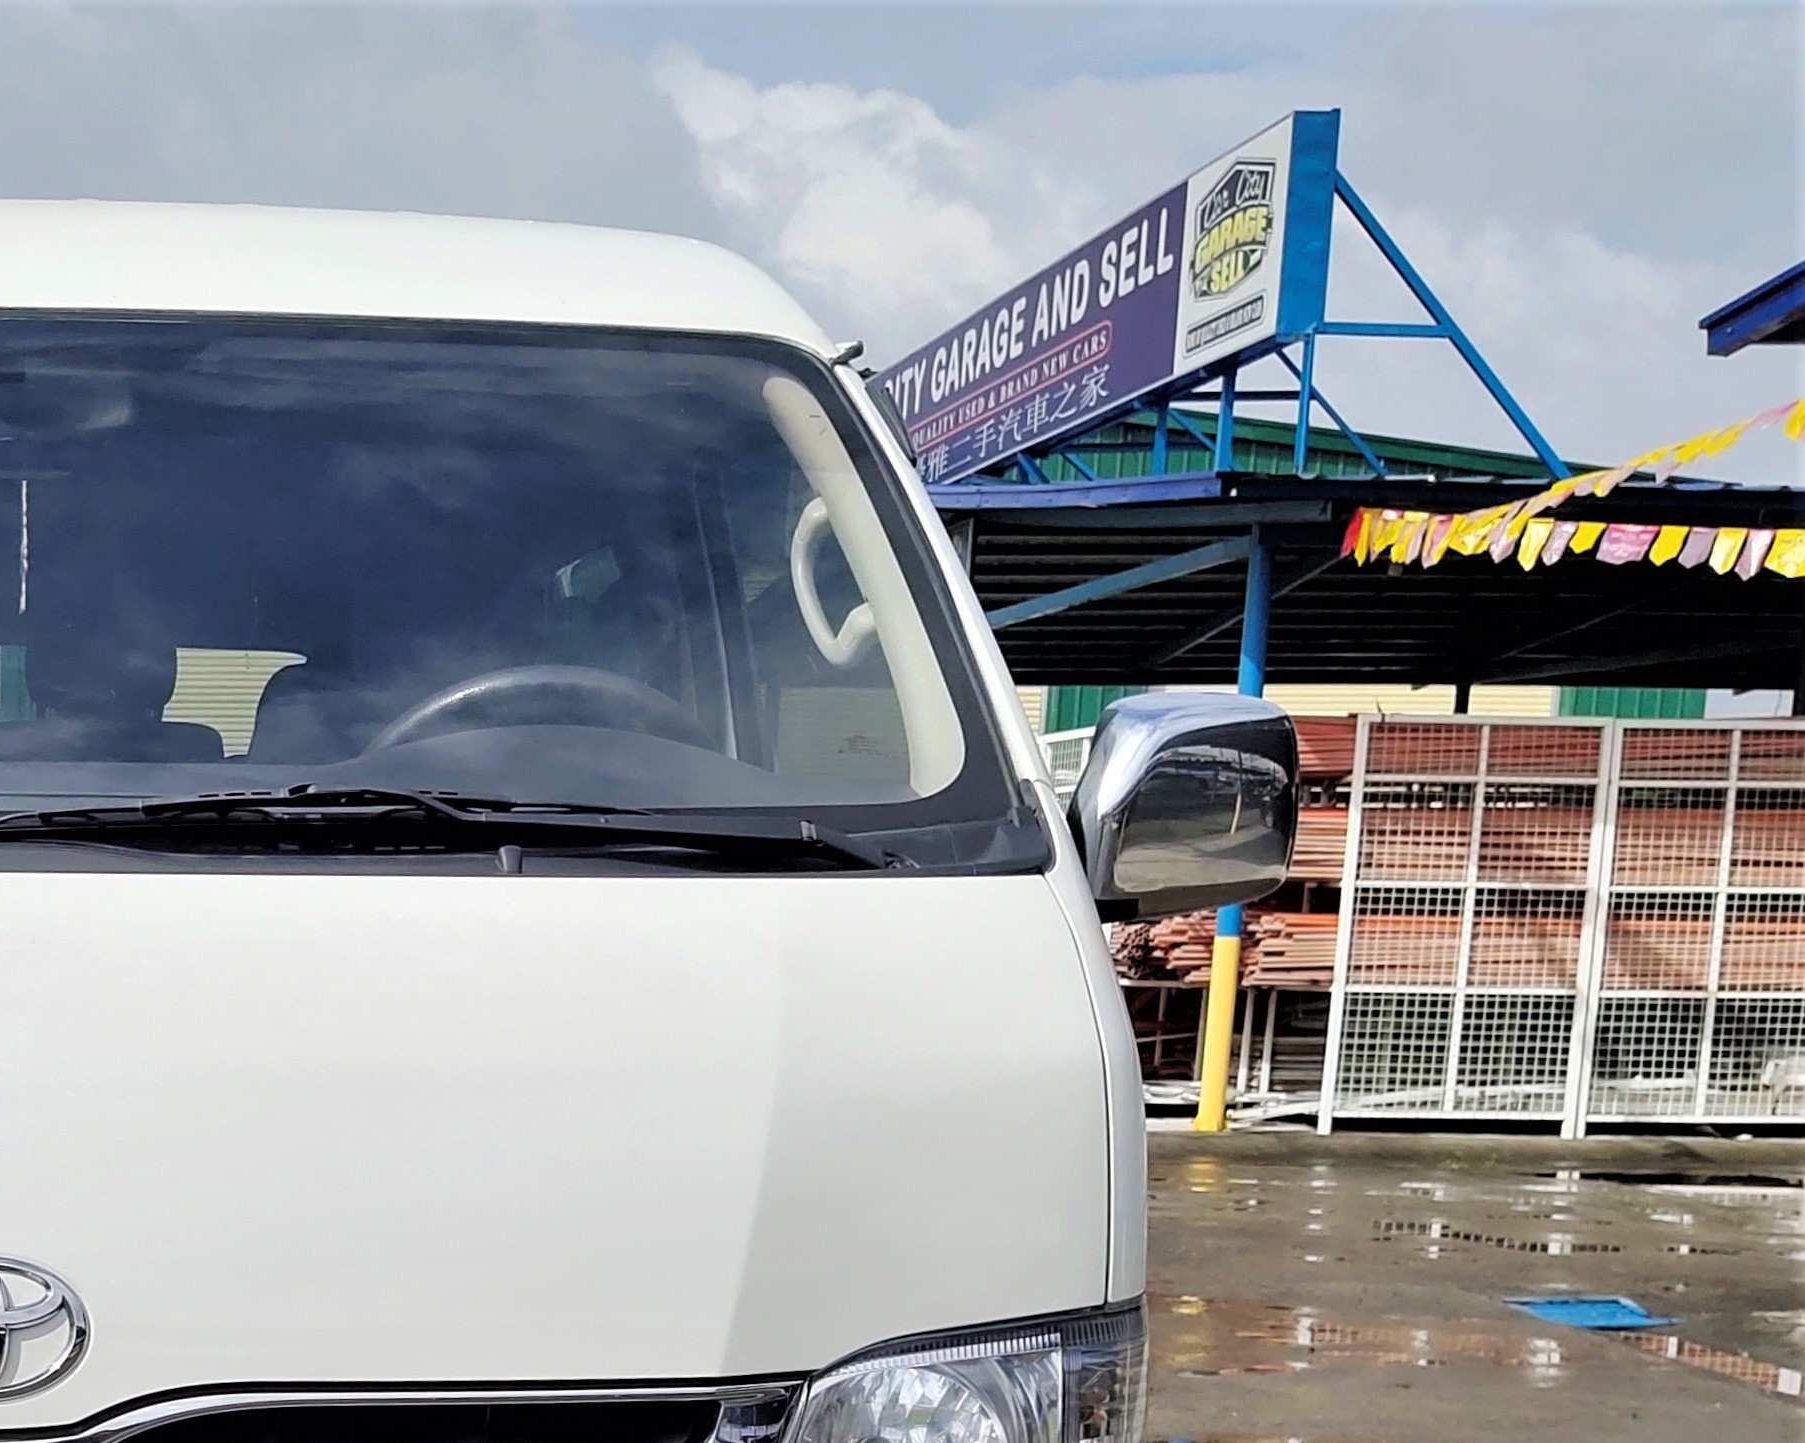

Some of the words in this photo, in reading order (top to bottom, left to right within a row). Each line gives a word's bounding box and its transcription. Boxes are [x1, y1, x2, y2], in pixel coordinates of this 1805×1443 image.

[1196, 205, 1268, 275] GARAGE
[1210, 249, 1246, 294] SELL
[931, 296, 1027, 403] GARAGE
[1031, 259, 1090, 348] AND
[1099, 207, 1174, 308] SELL
[912, 412, 956, 447] QUALITY
[958, 397, 985, 424] USED
[999, 368, 1038, 404] BRAND
[1042, 351, 1070, 381] NEW
[1073, 330, 1107, 364] CARS
